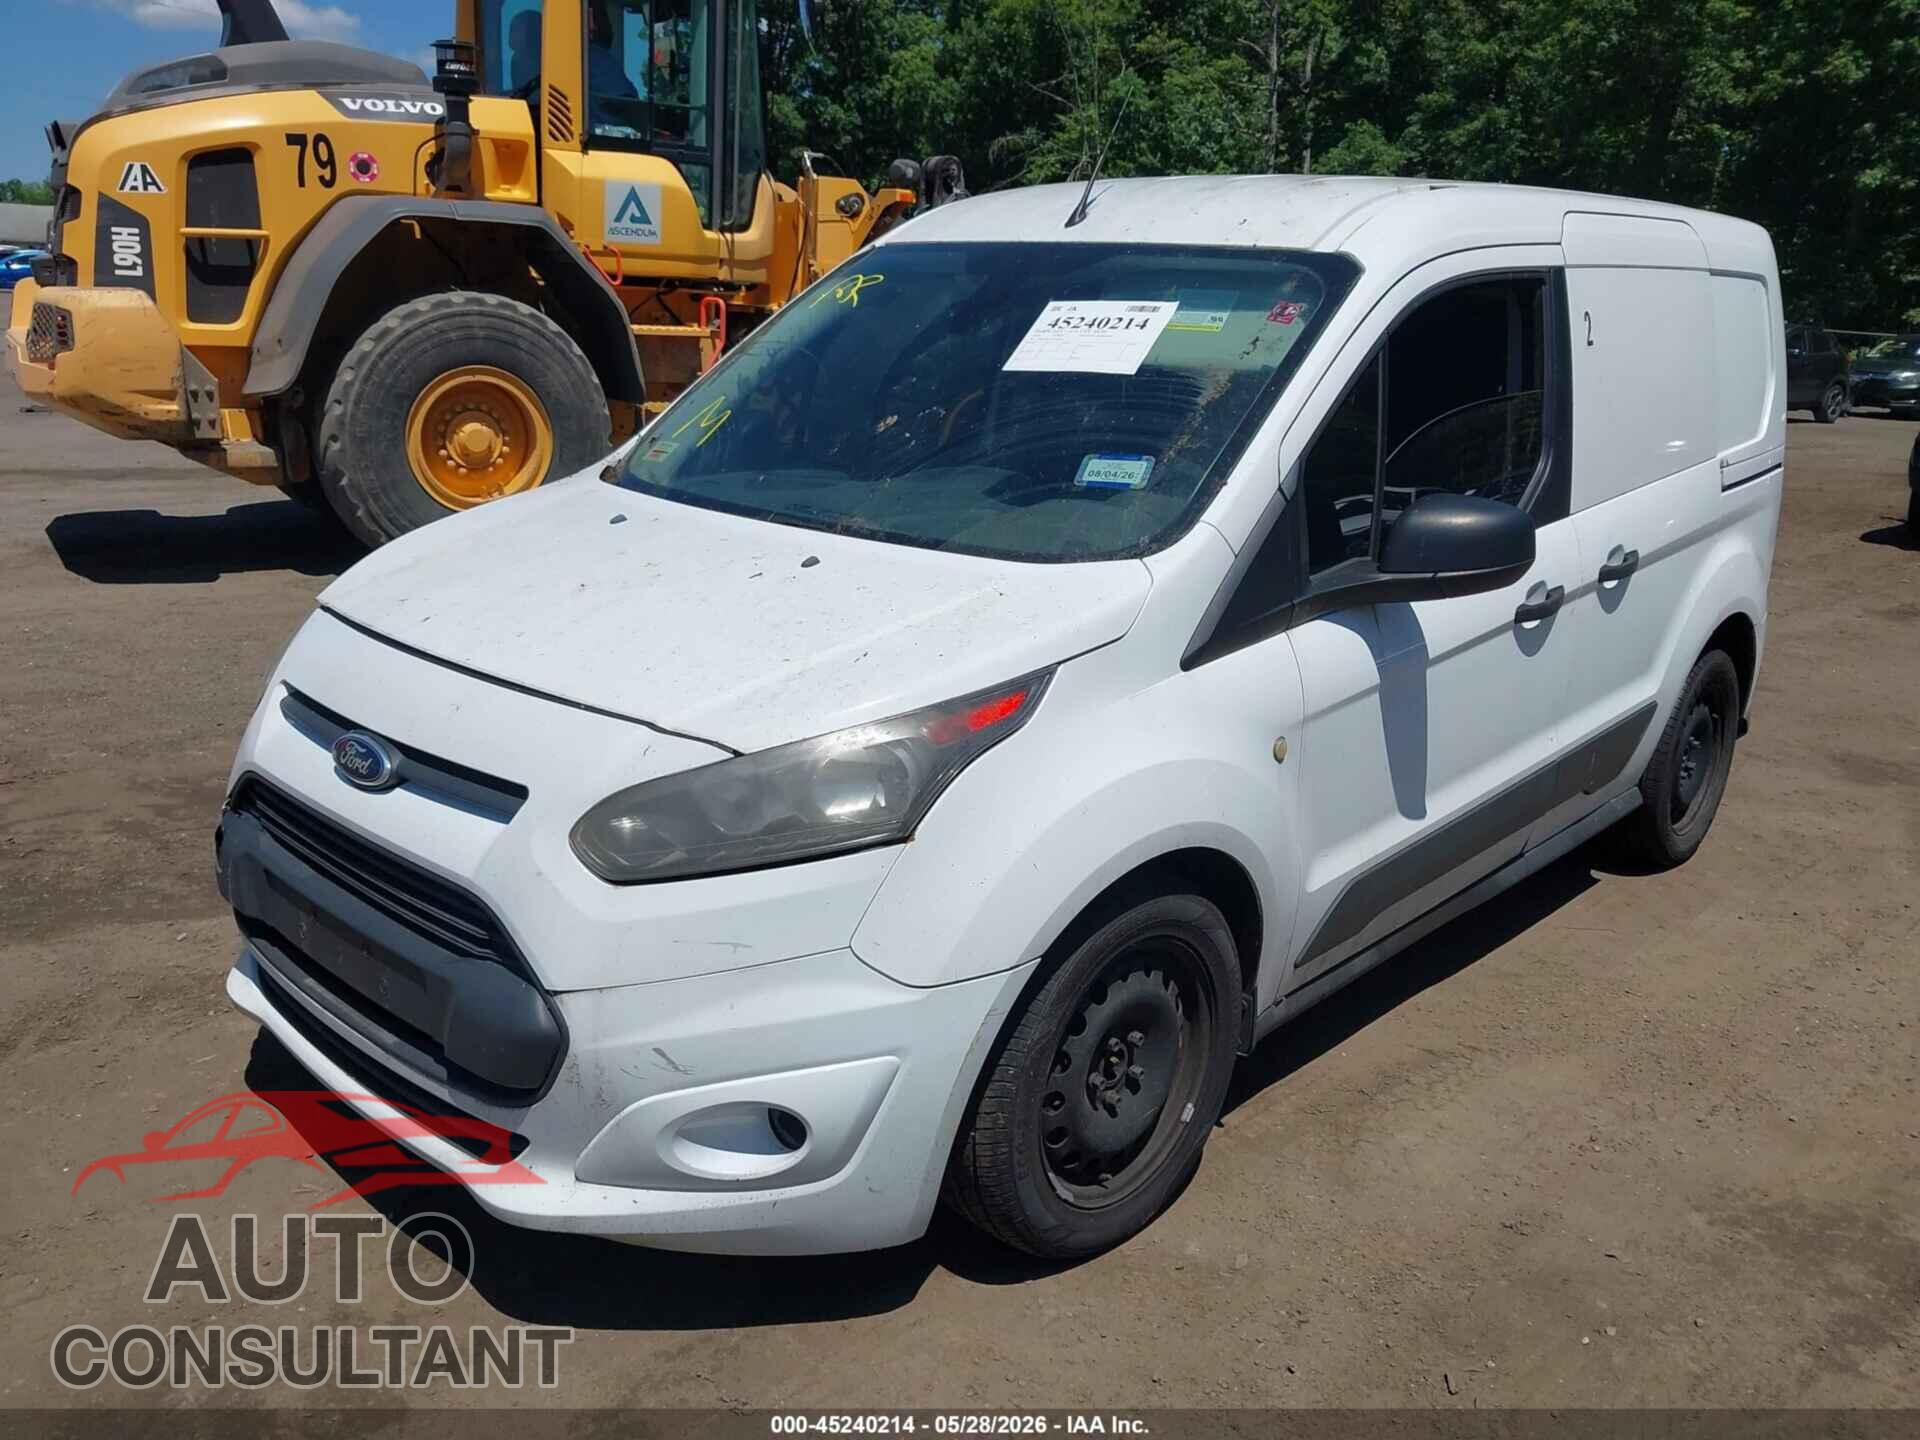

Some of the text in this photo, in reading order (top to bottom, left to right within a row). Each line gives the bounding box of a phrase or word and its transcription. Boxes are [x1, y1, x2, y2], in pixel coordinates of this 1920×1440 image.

[338, 97, 444, 115] VOLVO
[284, 132, 337, 189] 79
[110, 226, 143, 276] L90H
[1047, 316, 1150, 331] 45240214
[1583, 310, 1594, 347] 2
[340, 740, 373, 775] Ford
